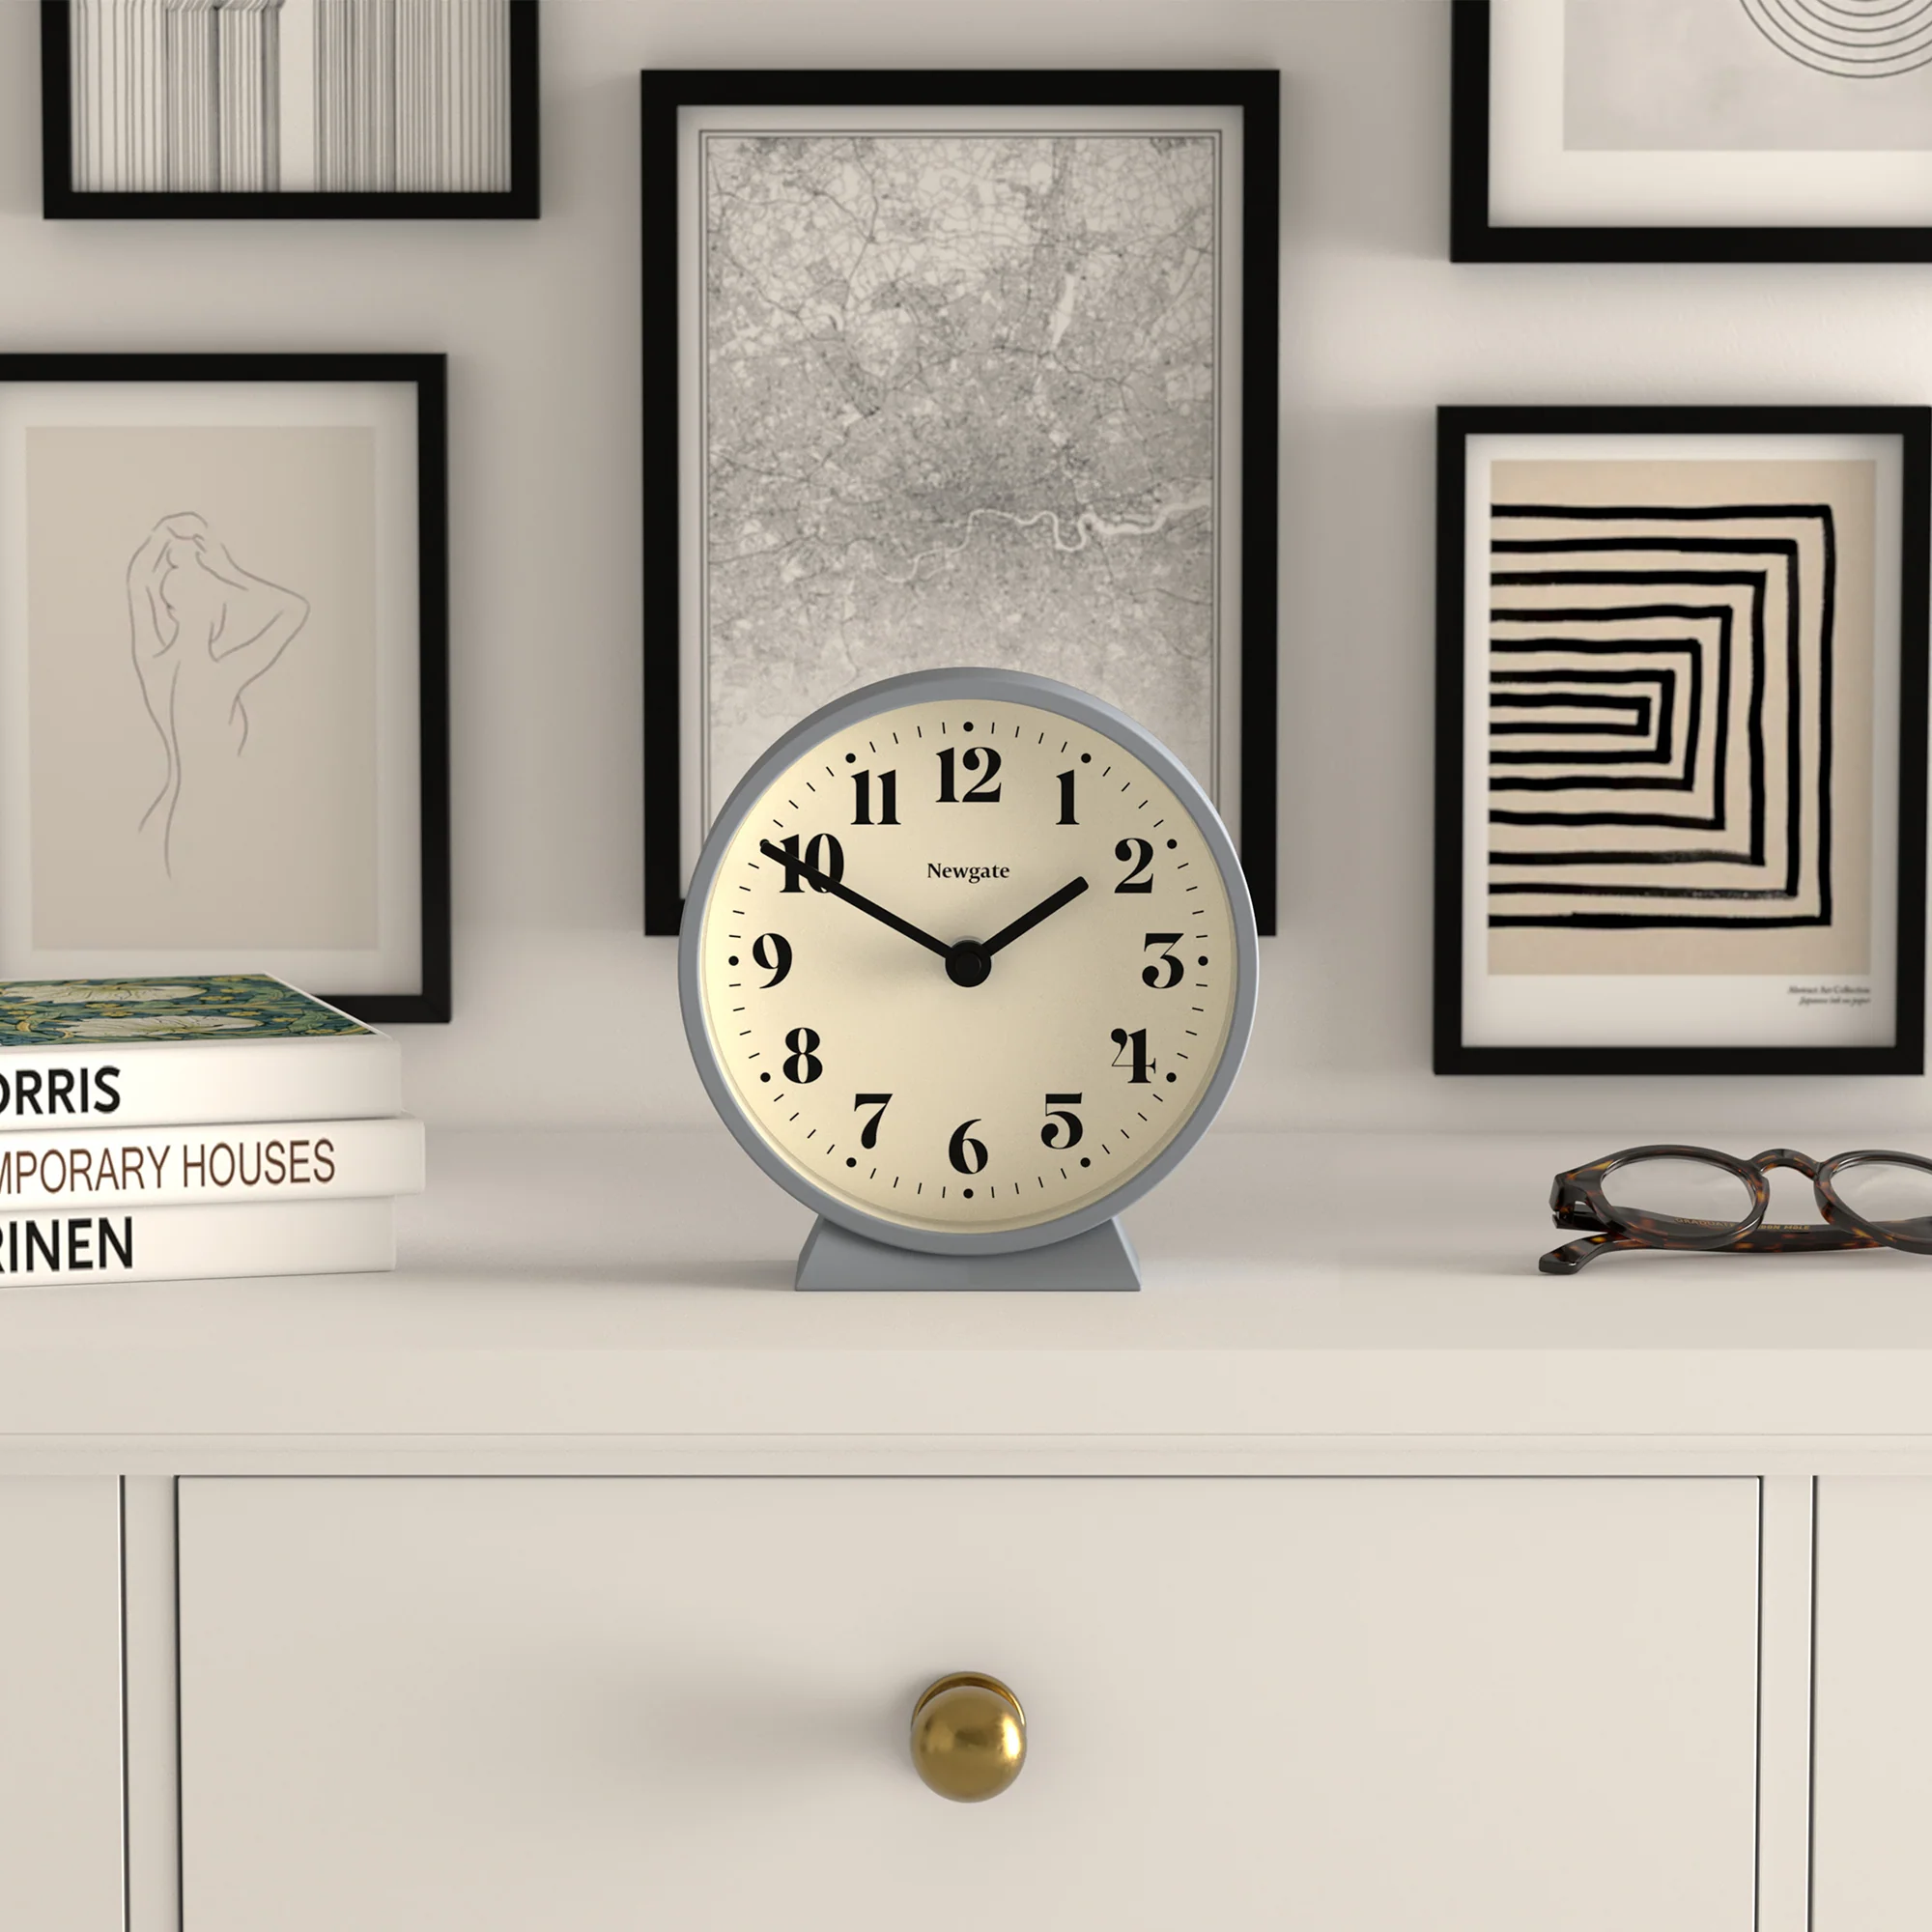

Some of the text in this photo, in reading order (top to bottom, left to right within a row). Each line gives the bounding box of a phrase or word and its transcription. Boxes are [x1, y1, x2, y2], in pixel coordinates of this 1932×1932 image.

[850, 769, 901, 825] 11
[934, 746, 1003, 803] 12
[1056, 769, 1080, 825] 1
[779, 833, 844, 894] 10
[926, 863, 1010, 884] Newgate
[1114, 838, 1154, 895] 2
[752, 932, 793, 989] 9
[1141, 932, 1184, 989] 3
[1833, 984, 1871, 994] Collection
[782, 1027, 823, 1084] 8
[1110, 1027, 1156, 1084] 4
[853, 1093, 894, 1150] 7
[948, 1118, 989, 1175] 6
[1040, 1092, 1084, 1151] 5
[183, 1138, 336, 1188] HOUSES
[0, 1216, 133, 1273] INEN
